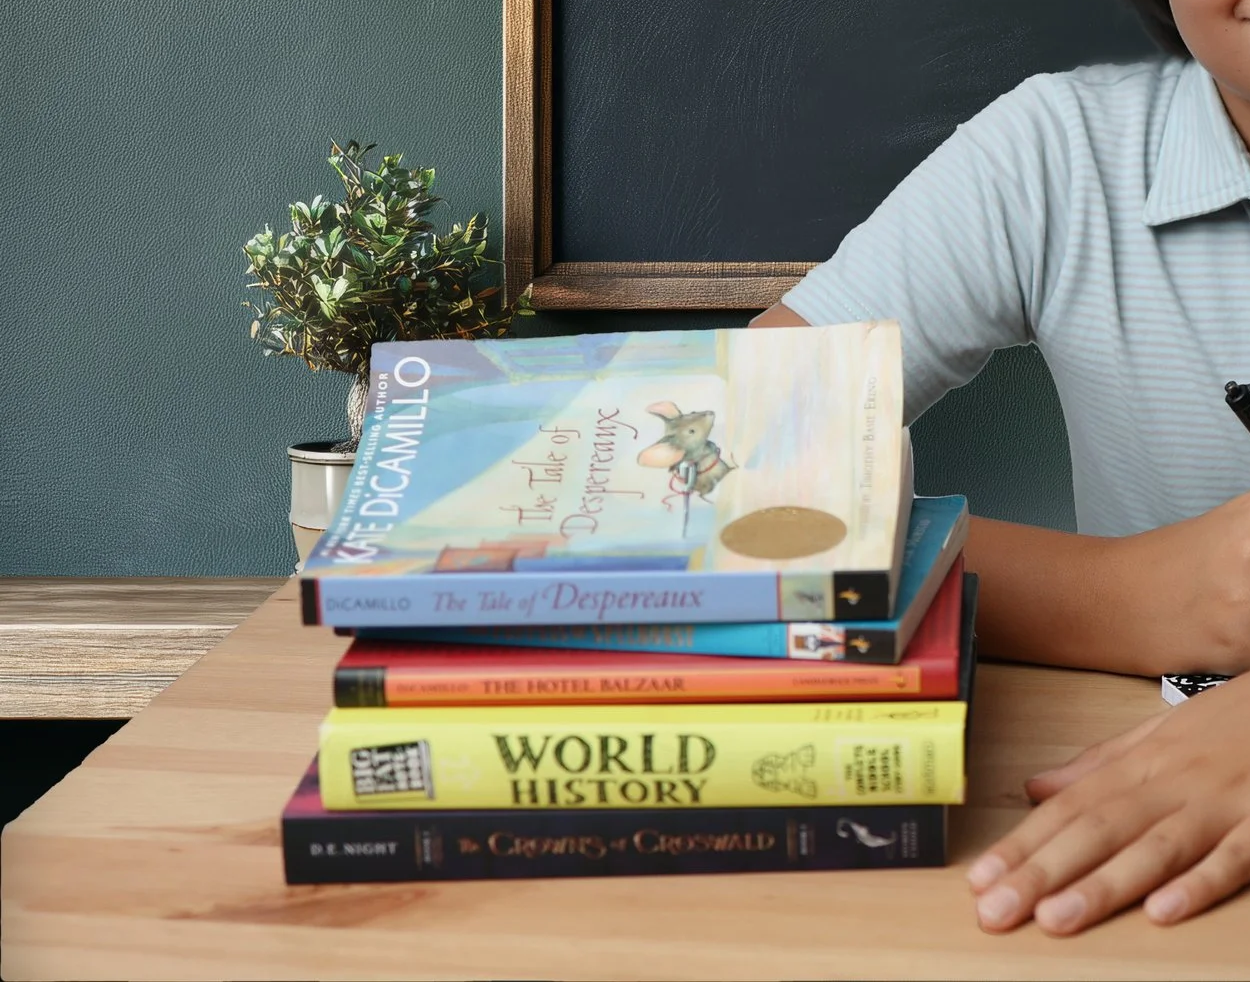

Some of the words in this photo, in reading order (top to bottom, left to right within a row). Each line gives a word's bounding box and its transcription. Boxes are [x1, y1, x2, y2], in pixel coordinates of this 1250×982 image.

[343, 488, 362, 514] TIMES
[355, 424, 382, 488] BEST-SELLING
[373, 373, 389, 421] AUTHOR
[359, 356, 431, 517] DiCAMILLO
[538, 424, 581, 445] of
[511, 451, 568, 490] Tale
[559, 408, 645, 539] Despereaux
[499, 493, 558, 526] The
[332, 522, 393, 564] KATE
[432, 591, 467, 613] The
[477, 591, 513, 612] Tale
[518, 592, 540, 618] of
[542, 582, 705, 621] Despereaux
[481, 679, 520, 695] THE
[527, 678, 594, 694] HOTEL
[600, 676, 685, 693] BALZAAR
[352, 749, 375, 793] BIG
[492, 733, 717, 778] WORLD
[510, 777, 709, 807] HISTORY
[343, 840, 399, 857] NIGHT
